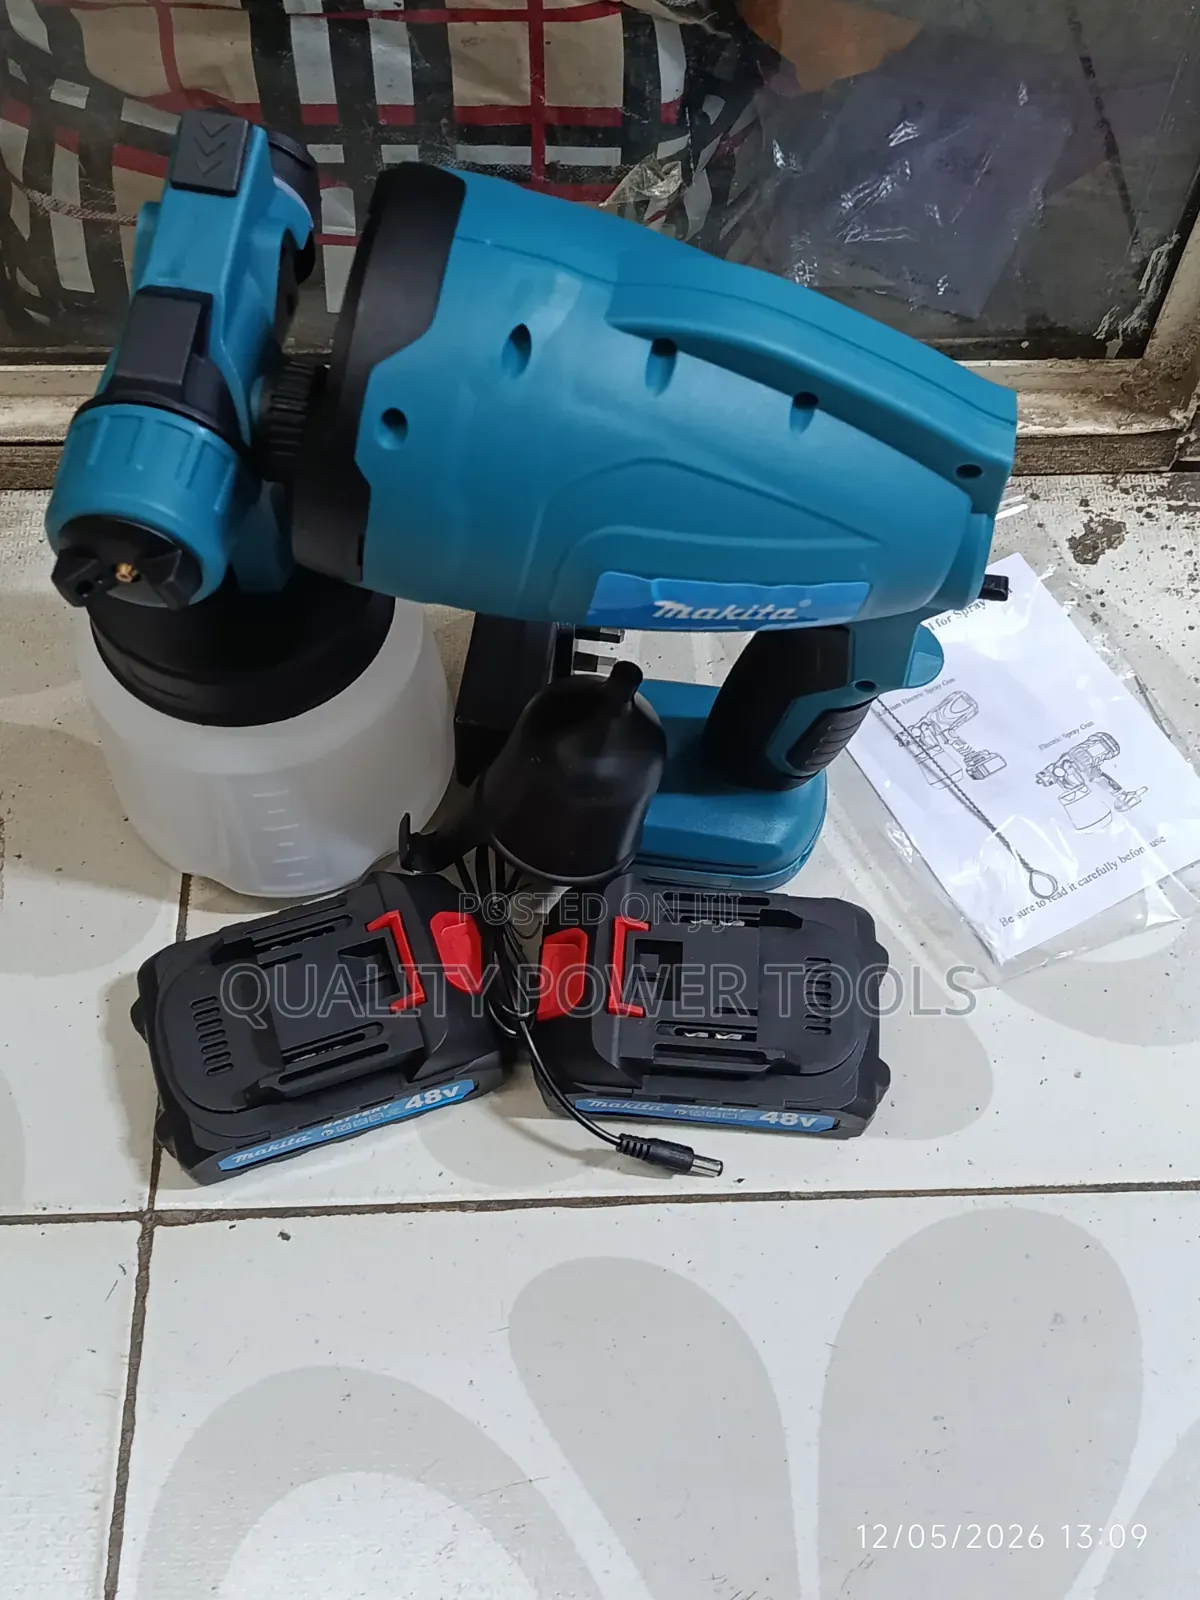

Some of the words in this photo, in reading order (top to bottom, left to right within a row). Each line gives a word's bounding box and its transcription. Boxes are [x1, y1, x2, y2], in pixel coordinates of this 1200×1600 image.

[935, 615, 952, 628] for
[953, 599, 986, 619] Spray
[999, 913, 1015, 927] Be
[1016, 904, 1036, 919] sure
[1035, 898, 1047, 910] to
[1067, 882, 1077, 892] it
[1077, 858, 1119, 888] carefully
[1117, 846, 1146, 864] befor
[1149, 836, 1166, 848] use
